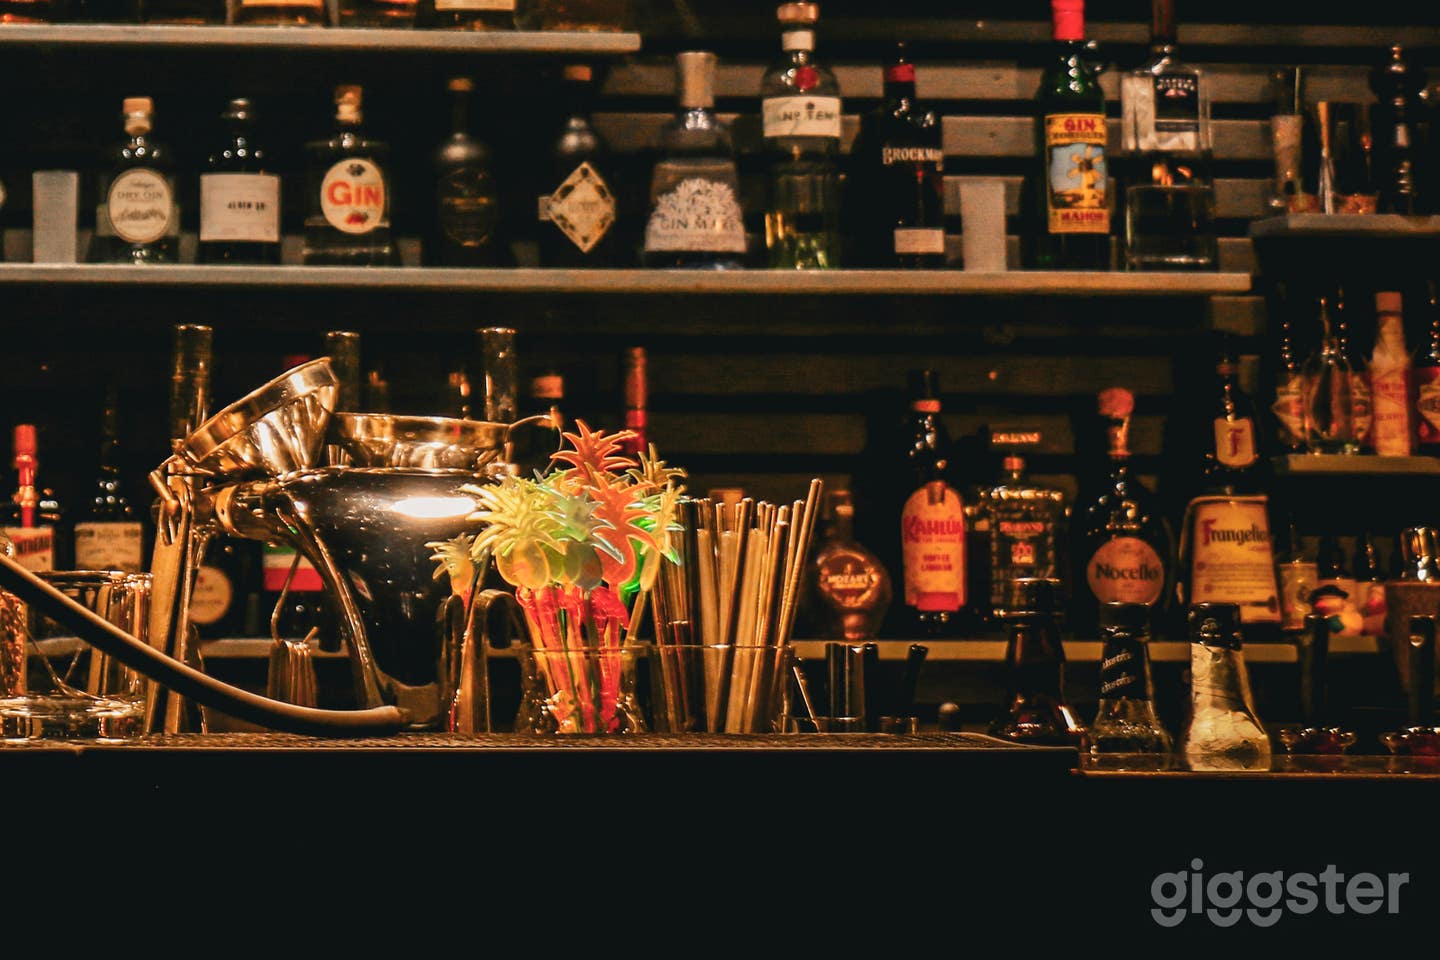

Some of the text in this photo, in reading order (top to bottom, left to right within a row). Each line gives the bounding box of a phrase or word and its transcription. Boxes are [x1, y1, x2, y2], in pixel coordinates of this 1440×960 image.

[1063, 118, 1096, 132] GIN
[327, 180, 380, 207] GIN
[1095, 563, 1158, 581] Nocello
